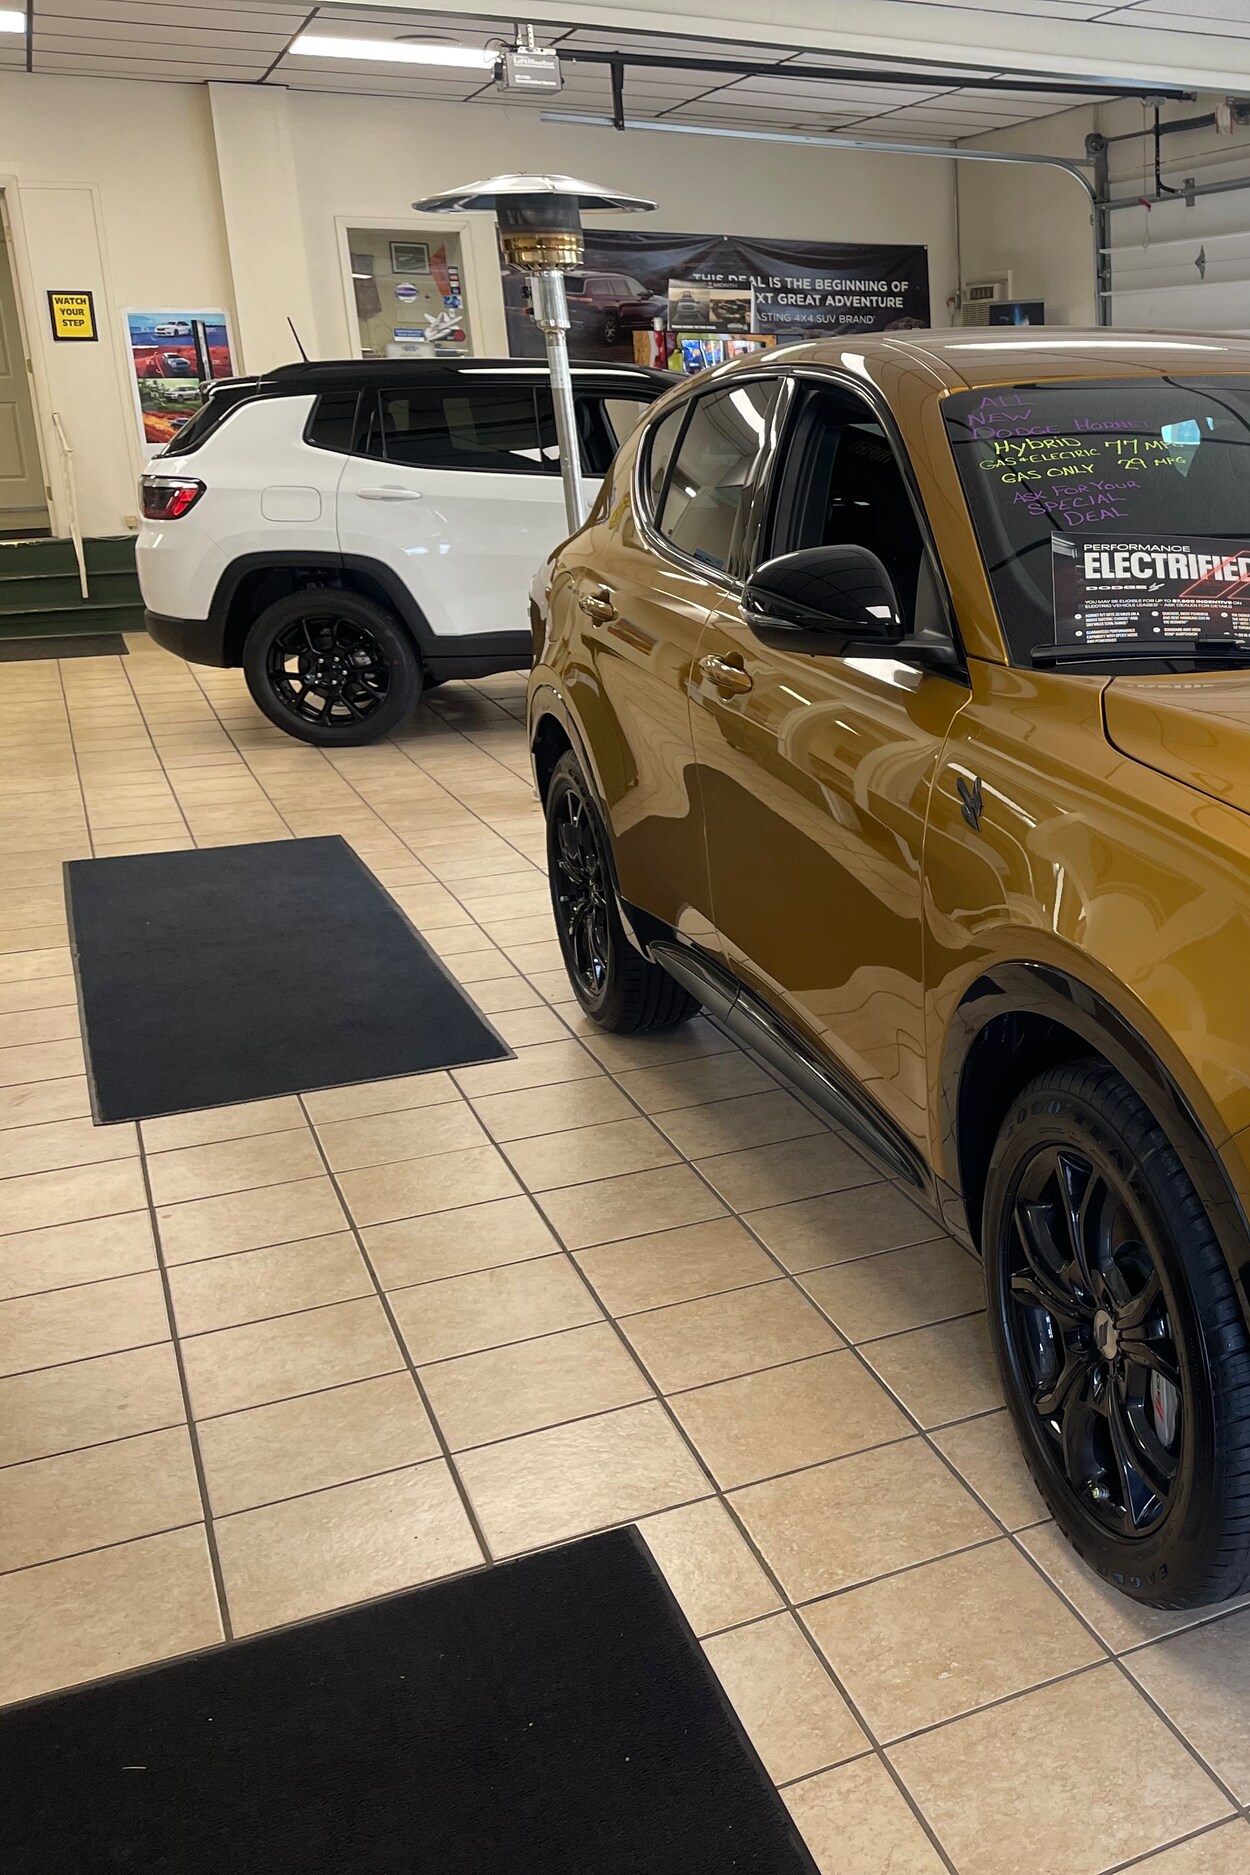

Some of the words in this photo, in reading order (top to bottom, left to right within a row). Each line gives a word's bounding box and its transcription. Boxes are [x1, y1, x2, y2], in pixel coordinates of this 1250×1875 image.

[769, 277, 782, 288] IS
[785, 277, 811, 290] THE
[815, 278, 889, 293] BEGINNING
[891, 281, 909, 293] OF
[54, 297, 87, 305] WATCH
[777, 293, 825, 306] GREAT
[825, 295, 904, 308] ADVENTURE
[60, 308, 84, 316] YOUR
[793, 313, 814, 323] 4X4
[816, 314, 837, 324] SUV
[62, 319, 85, 327] STEP
[980, 395, 1037, 410] ALL
[967, 409, 1031, 426] NEW
[972, 425, 1060, 440] DODGE
[1104, 439, 1138, 455] 77
[979, 457, 1017, 470] GAS
[1029, 448, 1101, 463] ELECTRIC
[1154, 456, 1187, 467] MPG
[1001, 470, 1042, 484] GAS
[1046, 464, 1095, 478] ONLY
[1013, 490, 1047, 505] ASK
[1052, 485, 1088, 497] FOR
[1088, 480, 1141, 492] YOUR
[1027, 493, 1127, 516] SPECIAL
[1063, 507, 1130, 527] DEAL
[1084, 543, 1191, 553] PERFORMANCE
